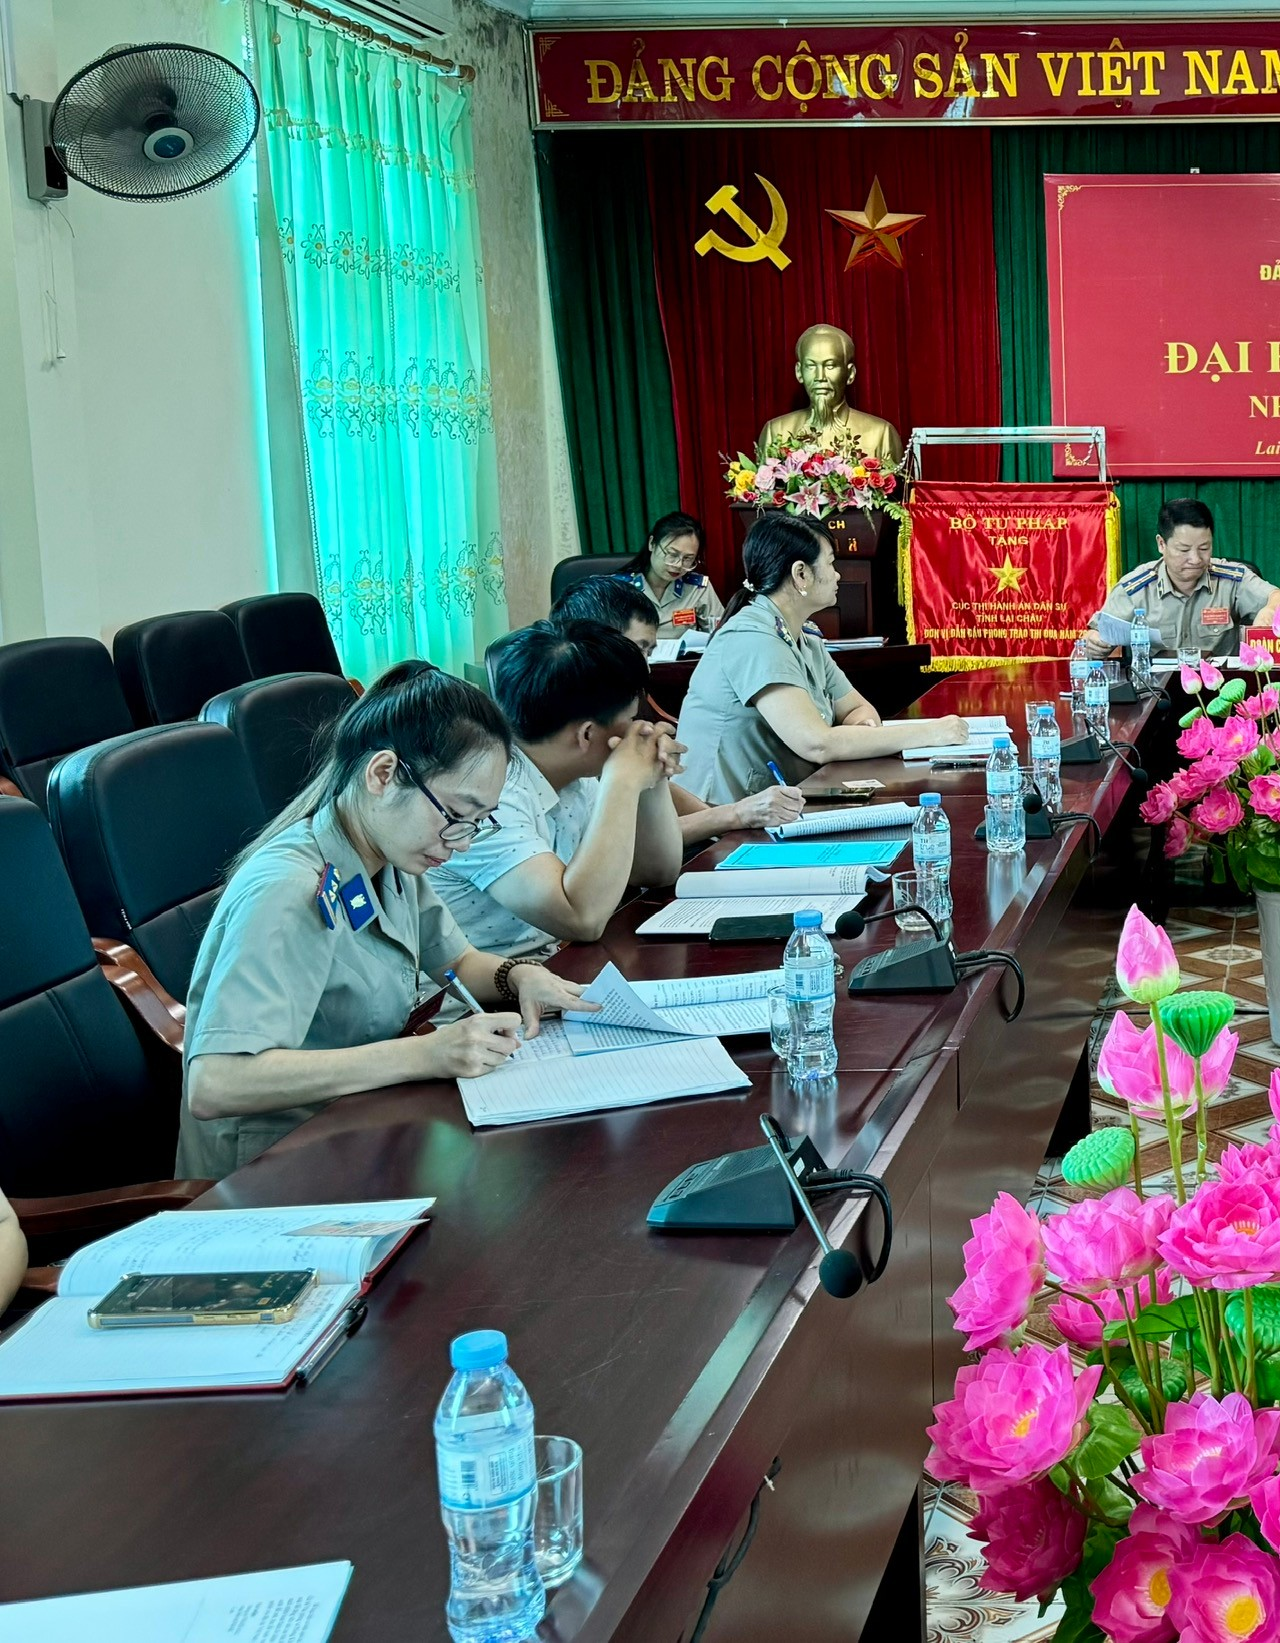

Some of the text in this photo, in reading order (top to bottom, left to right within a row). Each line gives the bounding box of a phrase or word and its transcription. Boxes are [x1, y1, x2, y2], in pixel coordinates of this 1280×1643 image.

[585, 38, 735, 104] ĐẢNG
[751, 41, 899, 113] CỘNG
[912, 32, 1019, 99] SẢN
[1037, 38, 1165, 108] VIỆT
[1163, 341, 1253, 383] ĐẠI
[949, 514, 1068, 535] BỘ TƯ PHÁP
